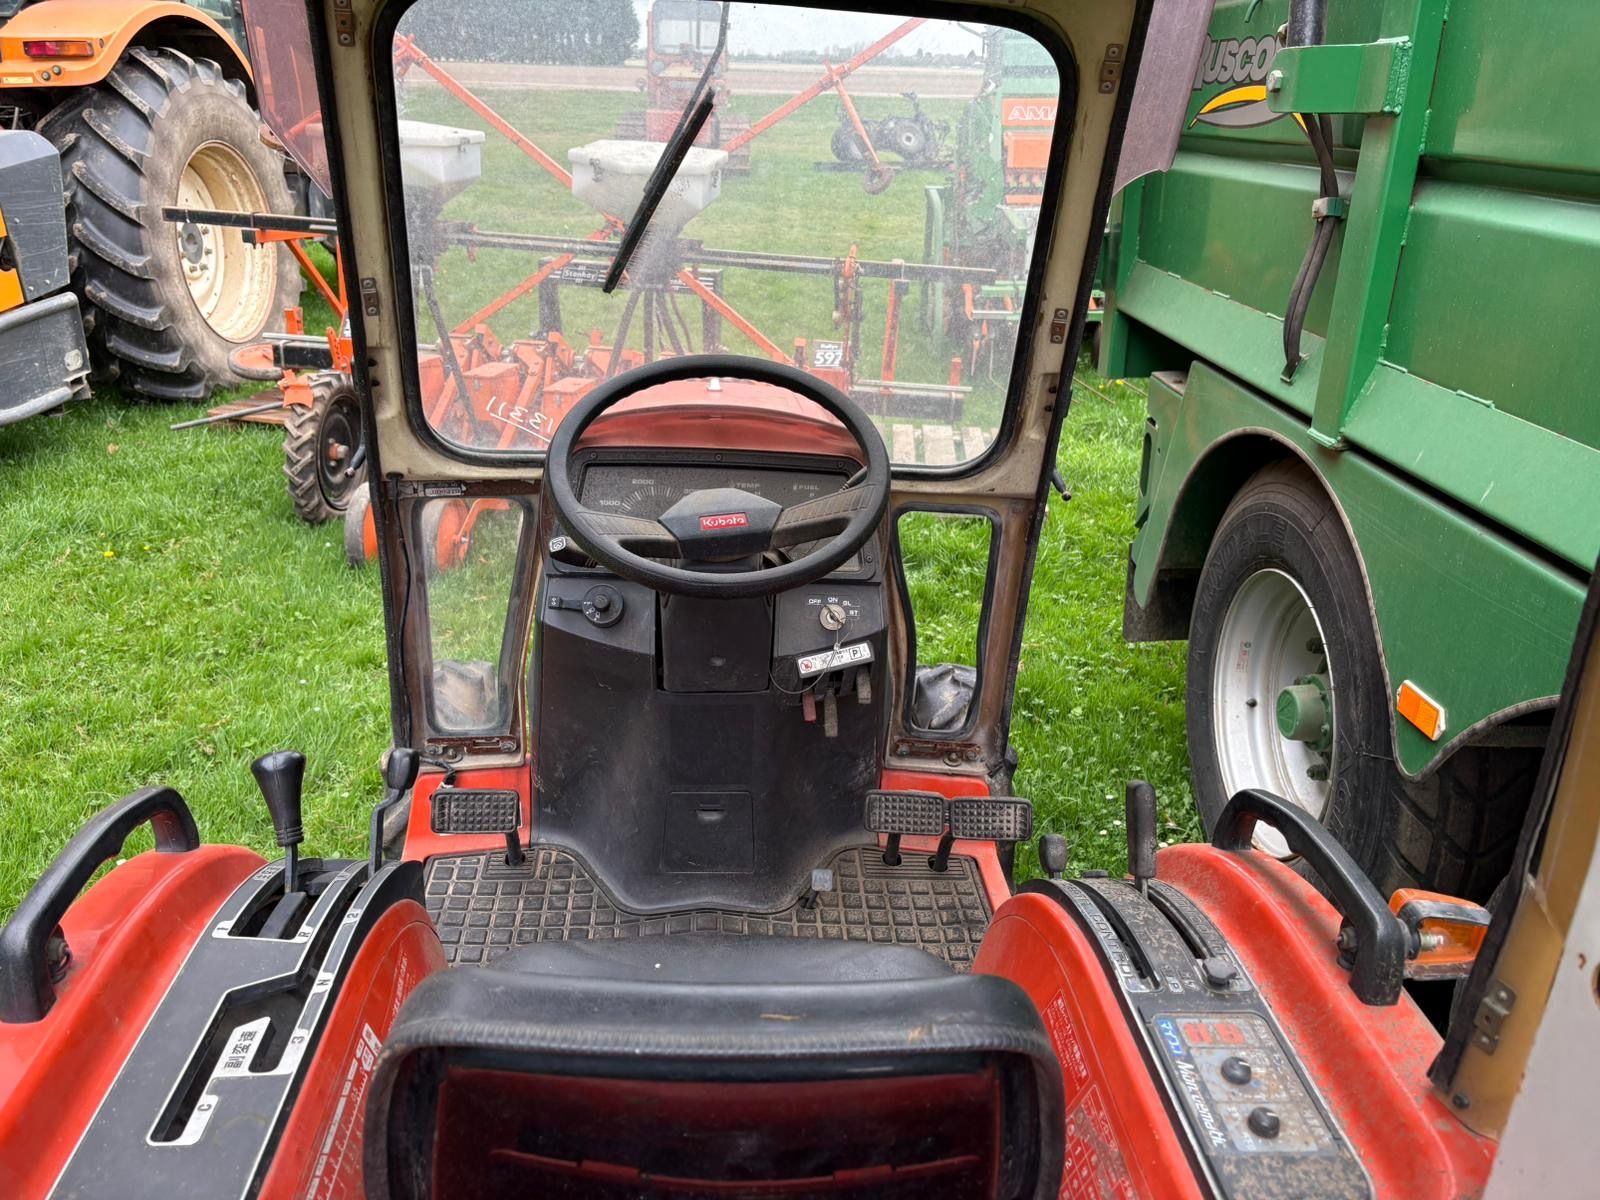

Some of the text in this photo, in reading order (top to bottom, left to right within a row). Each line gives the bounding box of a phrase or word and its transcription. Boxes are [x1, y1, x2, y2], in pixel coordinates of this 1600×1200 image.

[703, 516, 745, 527] Kubota
[291, 1036, 305, 1044] 3
[224, 1030, 257, 1069] 副変速
[197, 1103, 212, 1112] C
